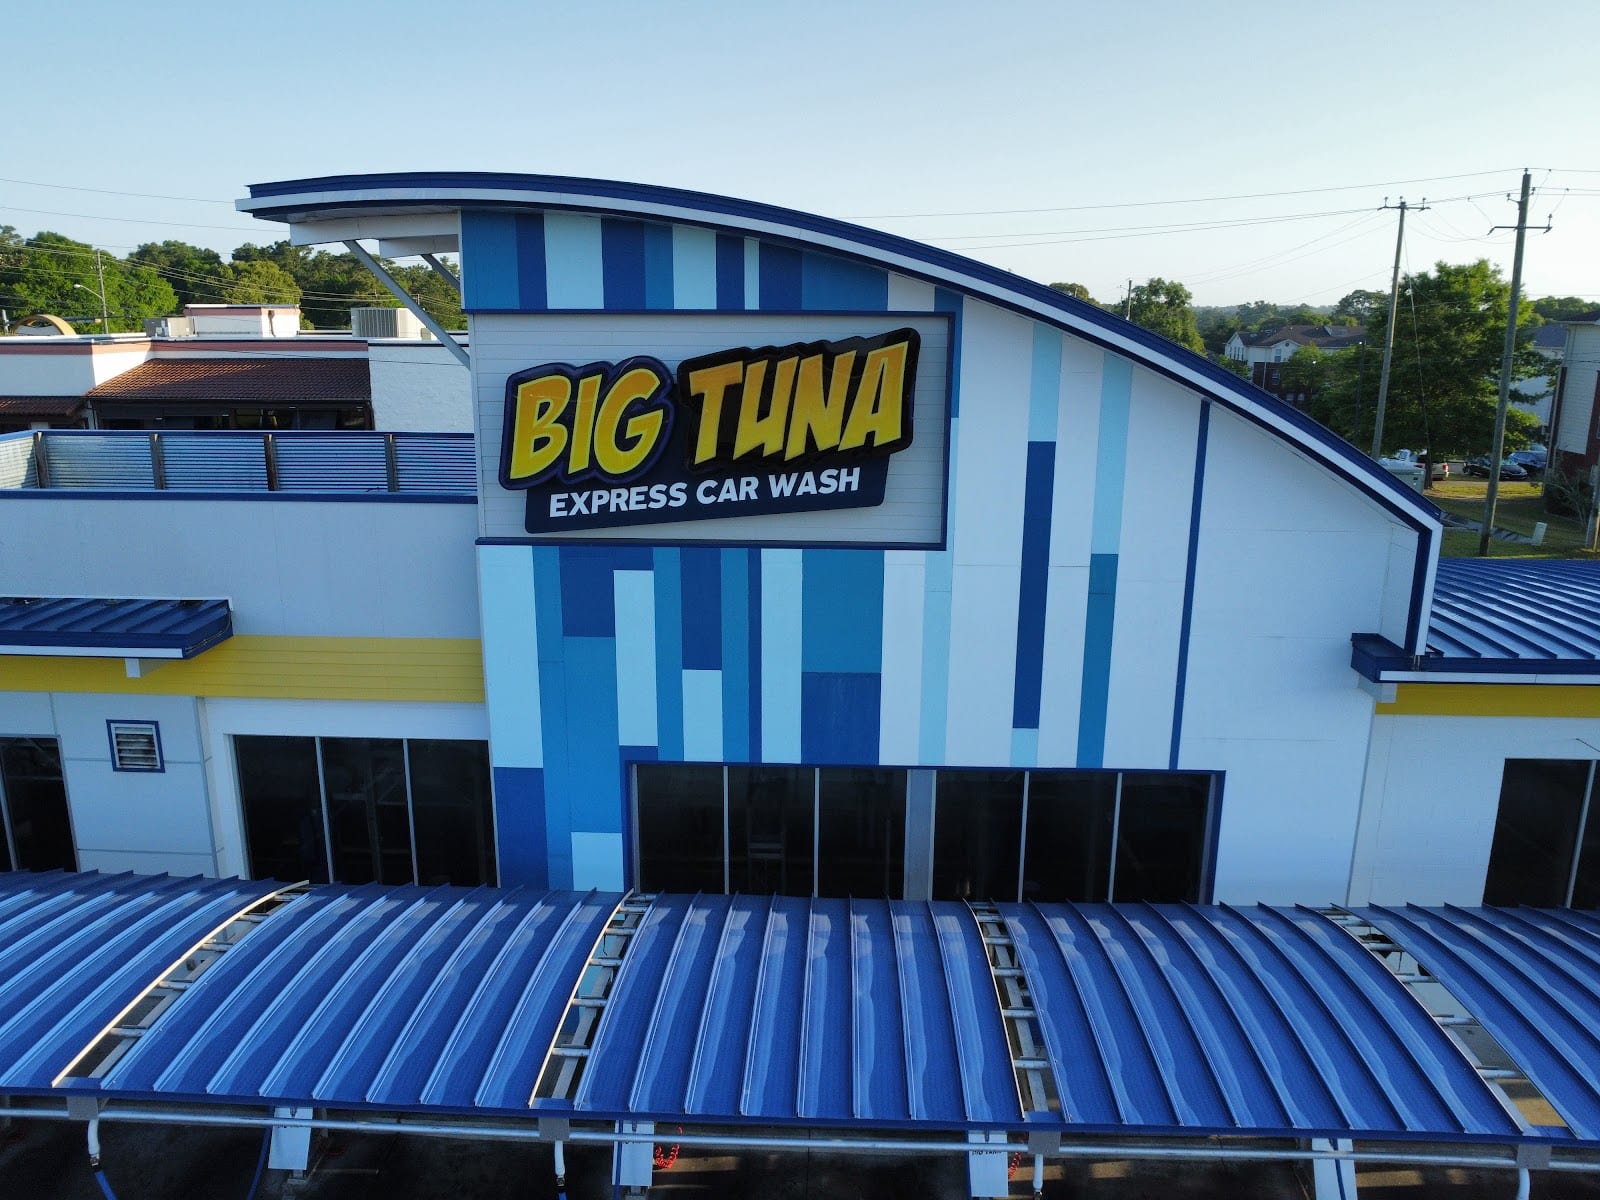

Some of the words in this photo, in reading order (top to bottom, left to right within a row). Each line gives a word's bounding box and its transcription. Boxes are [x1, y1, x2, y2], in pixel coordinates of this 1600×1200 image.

[509, 368, 663, 480] BIG
[689, 341, 909, 465] TUNA
[549, 484, 688, 518] EXPRESS
[696, 476, 758, 505] CAR
[769, 467, 861, 498] WASH
